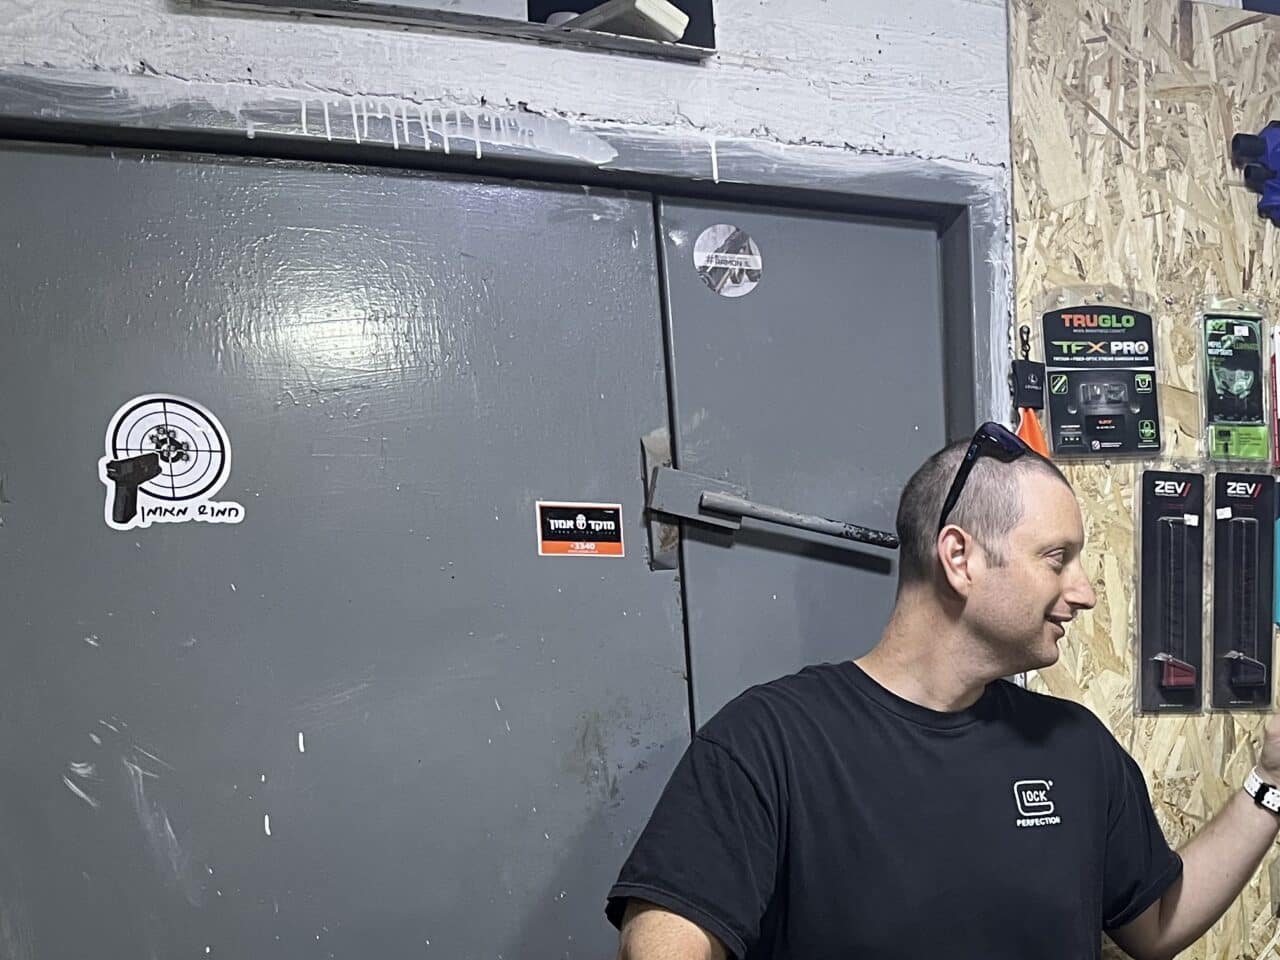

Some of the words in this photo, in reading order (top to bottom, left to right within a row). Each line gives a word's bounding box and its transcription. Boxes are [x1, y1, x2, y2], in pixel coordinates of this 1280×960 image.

[1061, 314, 1135, 327] TRUGLO
[1051, 341, 1109, 354] TFX
[1110, 341, 1149, 355] PRO
[1154, 480, 1185, 494] ZEV
[1226, 481, 1256, 495] ZEV
[141, 506, 188, 523] מאומן
[198, 505, 239, 518] חמוש
[549, 519, 575, 530] אמון
[588, 520, 615, 531] מוקד
[1016, 816, 1061, 827] PERFECTION
